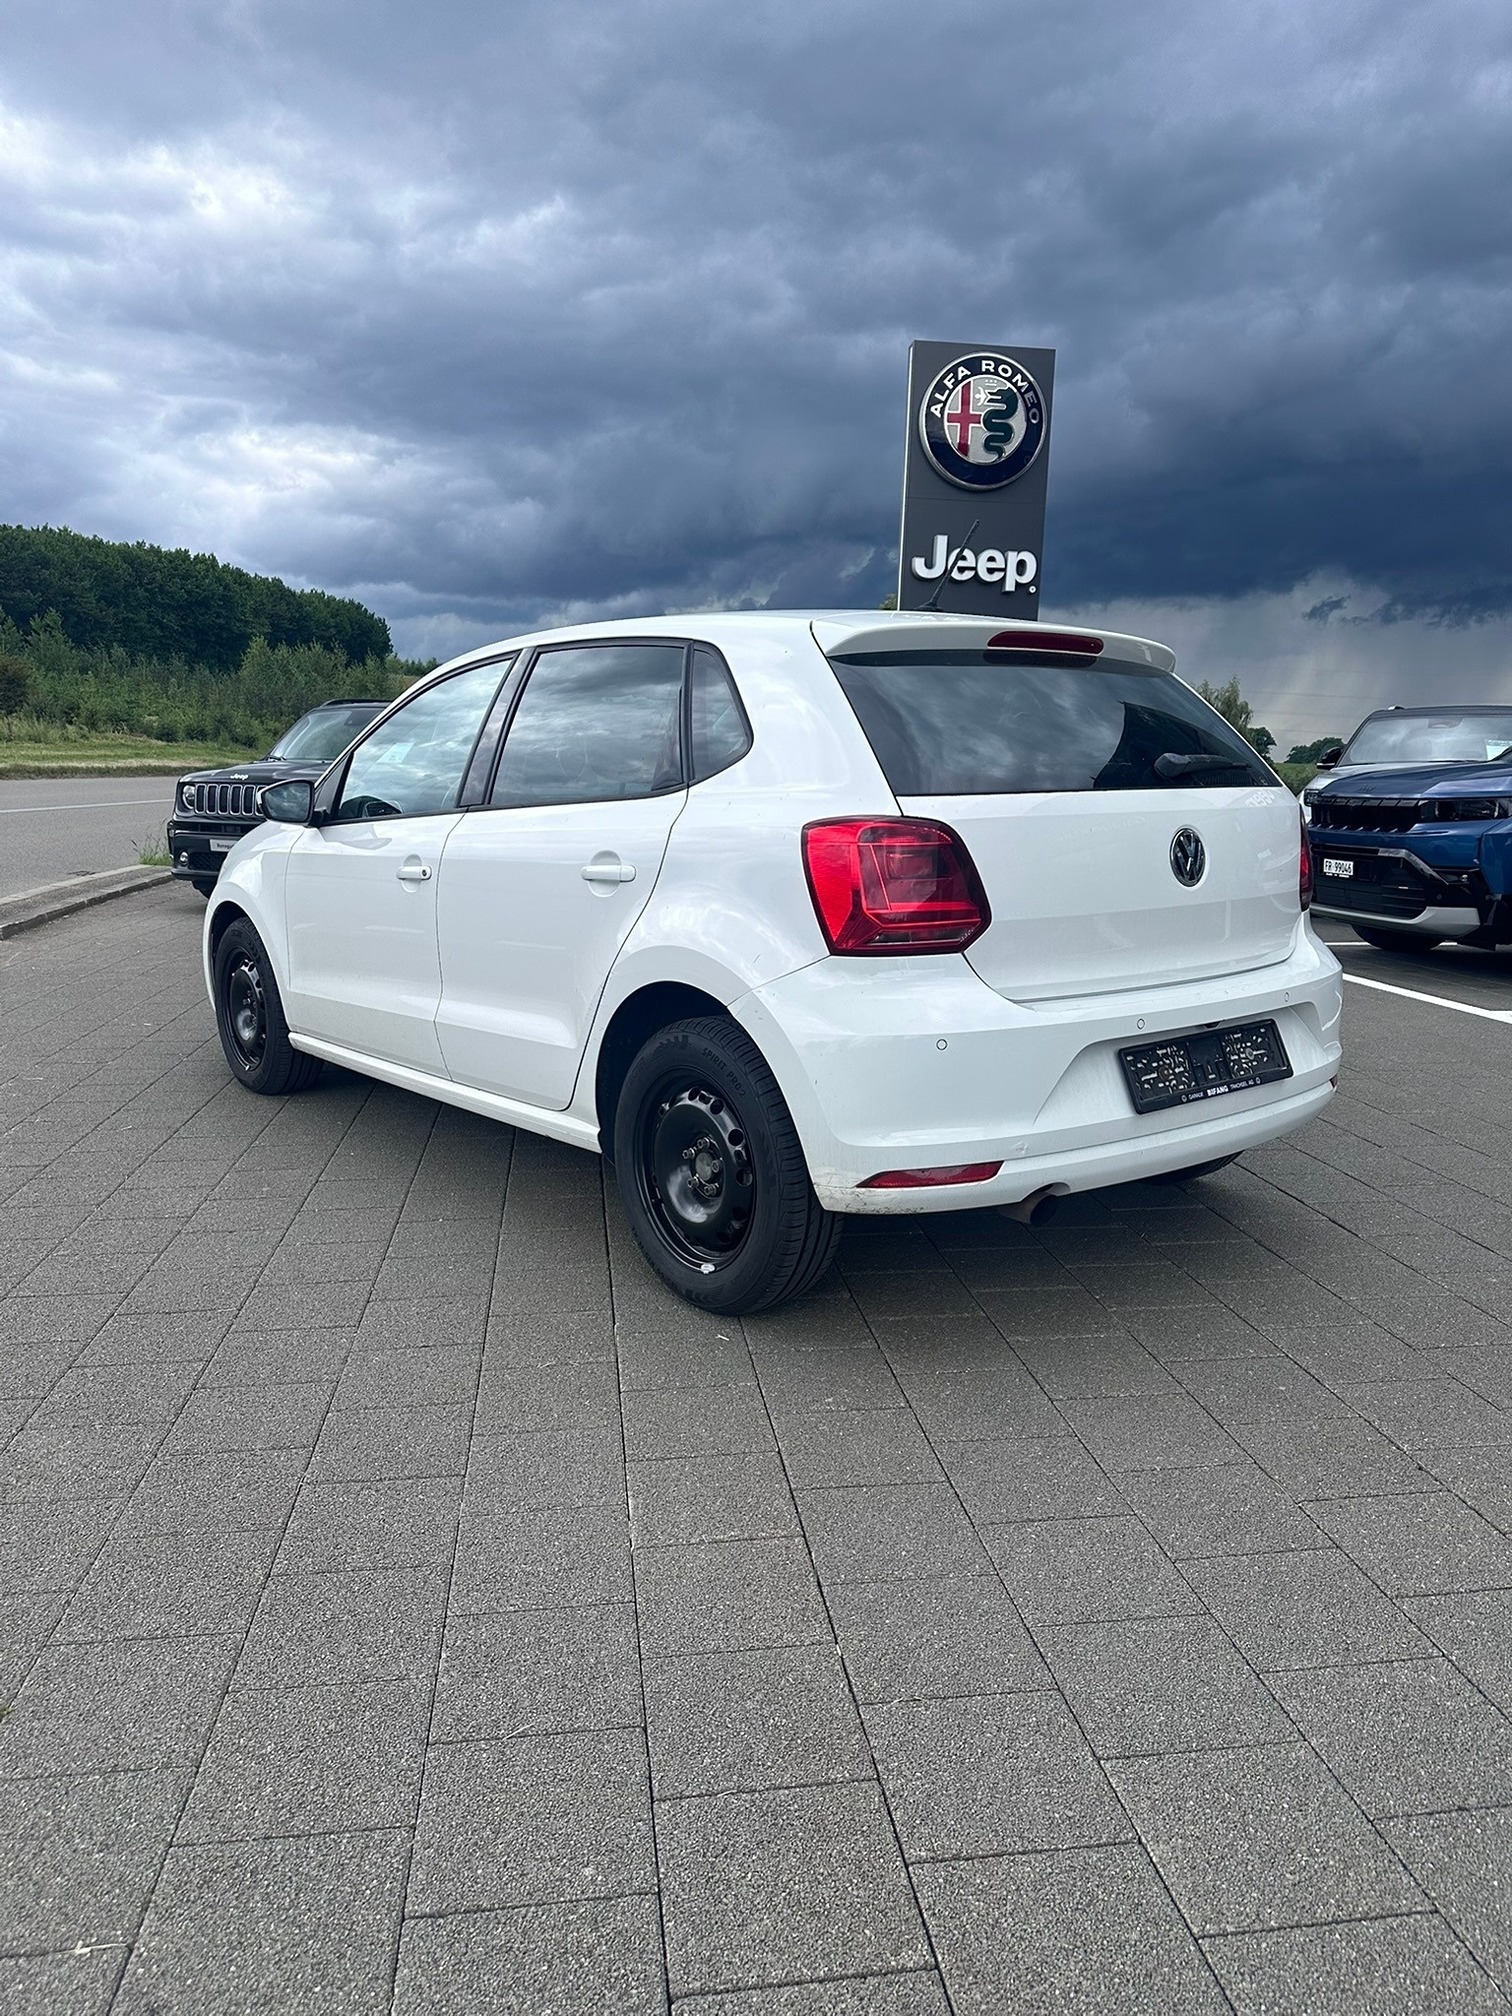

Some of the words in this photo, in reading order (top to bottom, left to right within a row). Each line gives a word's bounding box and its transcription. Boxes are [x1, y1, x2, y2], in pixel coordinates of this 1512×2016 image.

[930, 365, 972, 418] ALFA
[981, 359, 1040, 425] ROMEO
[701, 1047, 727, 1070] SPIRIT
[1207, 1085, 1229, 1096] BIFANG
